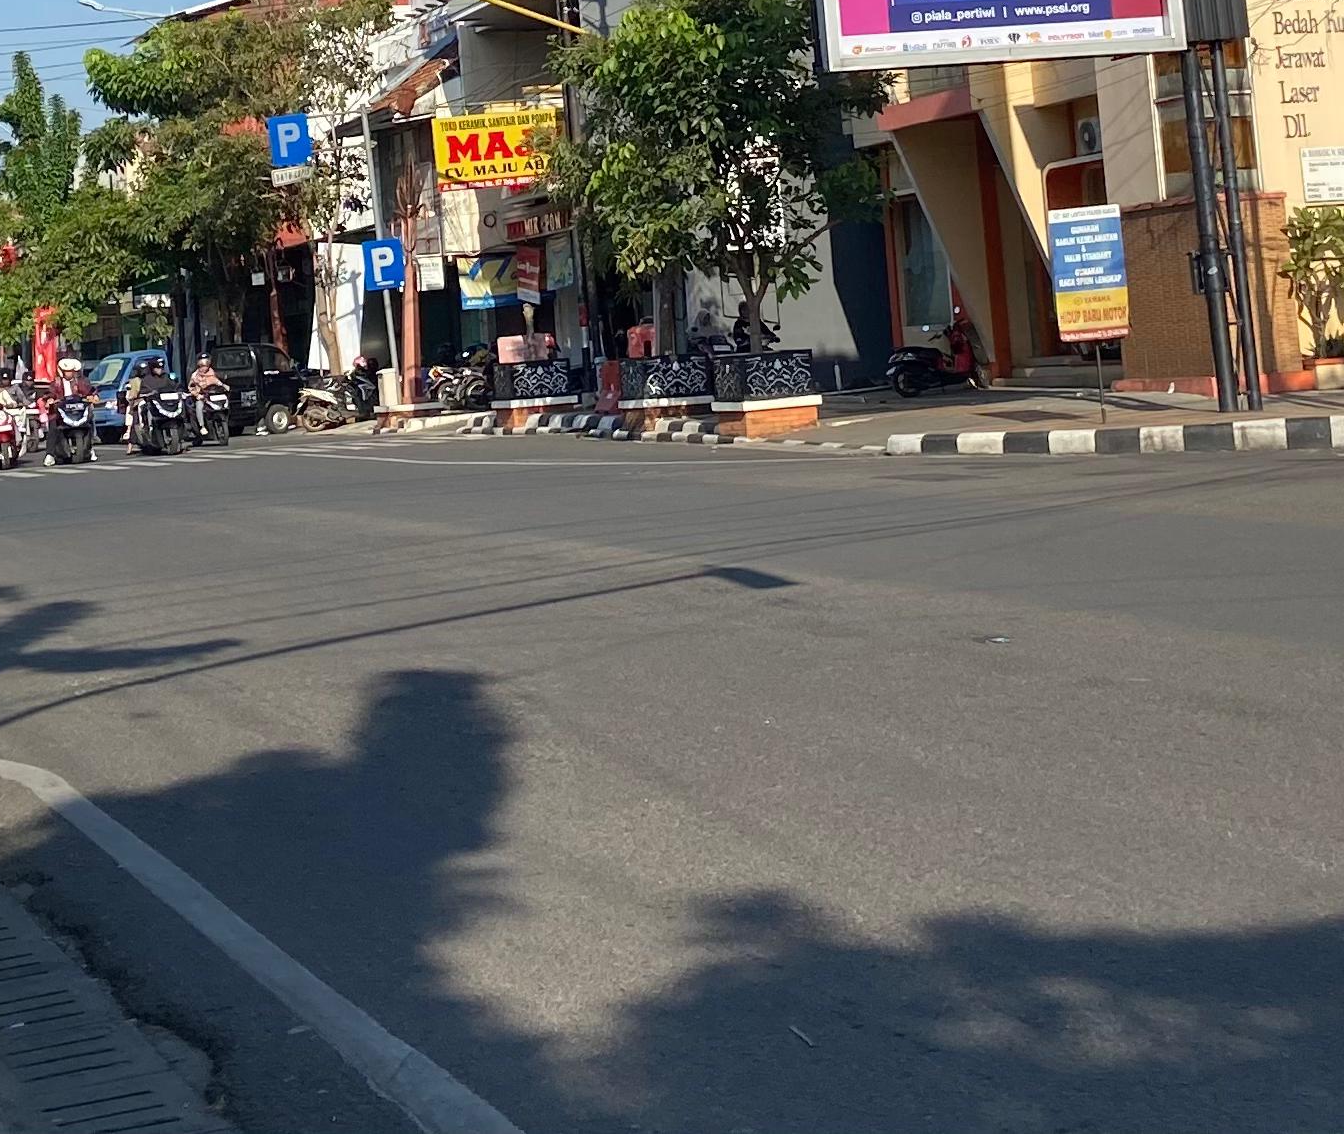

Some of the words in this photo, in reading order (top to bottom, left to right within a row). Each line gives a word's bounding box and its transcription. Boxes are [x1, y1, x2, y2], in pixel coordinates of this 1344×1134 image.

[1272, 10, 1319, 35] Bedah
[1275, 46, 1326, 70] Jerawat
[1279, 80, 1320, 105] Laser
[440, 121, 457, 132] TOKO
[517, 114, 530, 125] DAN
[277, 122, 301, 158] P
[445, 167, 469, 180] CV.
[474, 162, 518, 176] MAJU
[370, 245, 396, 281] P
